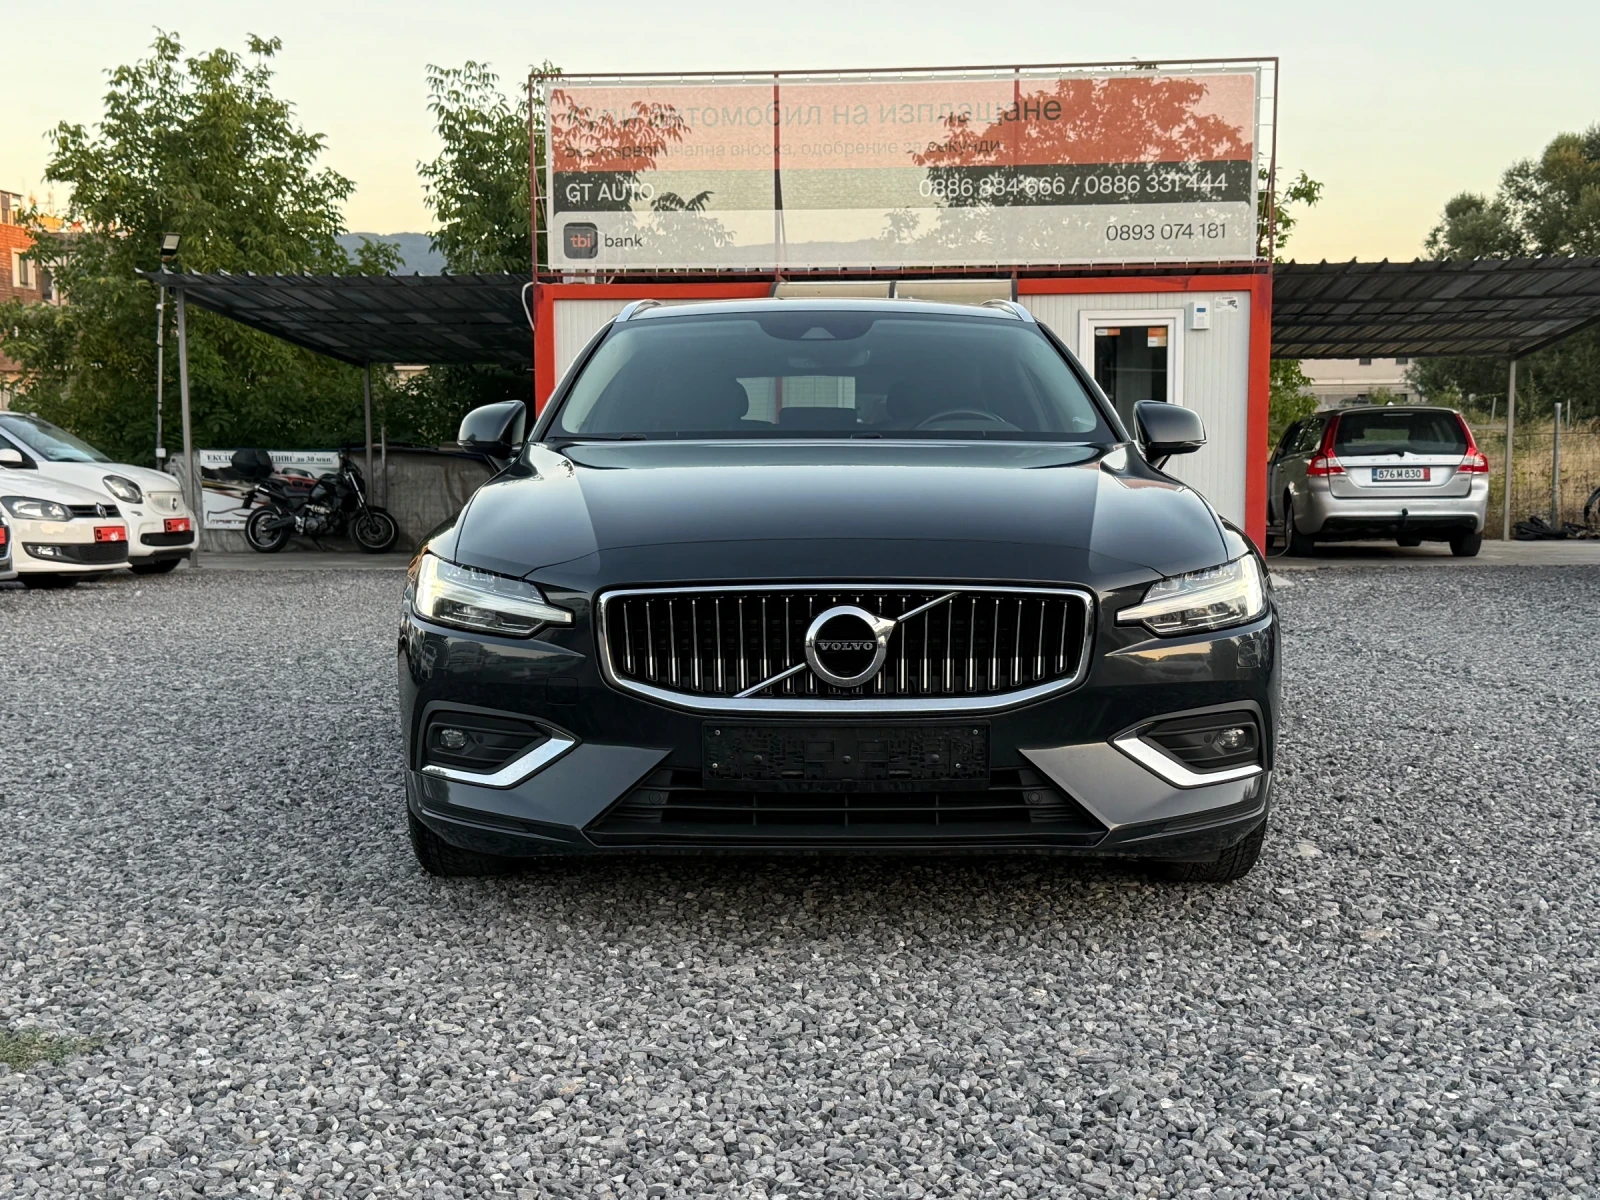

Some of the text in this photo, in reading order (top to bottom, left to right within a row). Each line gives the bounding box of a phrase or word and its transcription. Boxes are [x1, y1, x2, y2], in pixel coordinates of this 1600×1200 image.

[649, 101, 821, 128] автомобил
[832, 104, 869, 125] на
[879, 99, 1062, 127] изплащане
[801, 140, 899, 158] одобрение
[927, 138, 1000, 155] секунди
[565, 183, 655, 202] GT AUTO
[919, 172, 1228, 198] 0886 884 666 / 0886 331 444
[570, 233, 592, 248] tbi
[604, 233, 643, 248] bank
[1106, 221, 1227, 241] 0893 074 181
[1378, 470, 1394, 478] 876
[1404, 470, 1421, 478] 830
[819, 642, 873, 651] VOLVO
